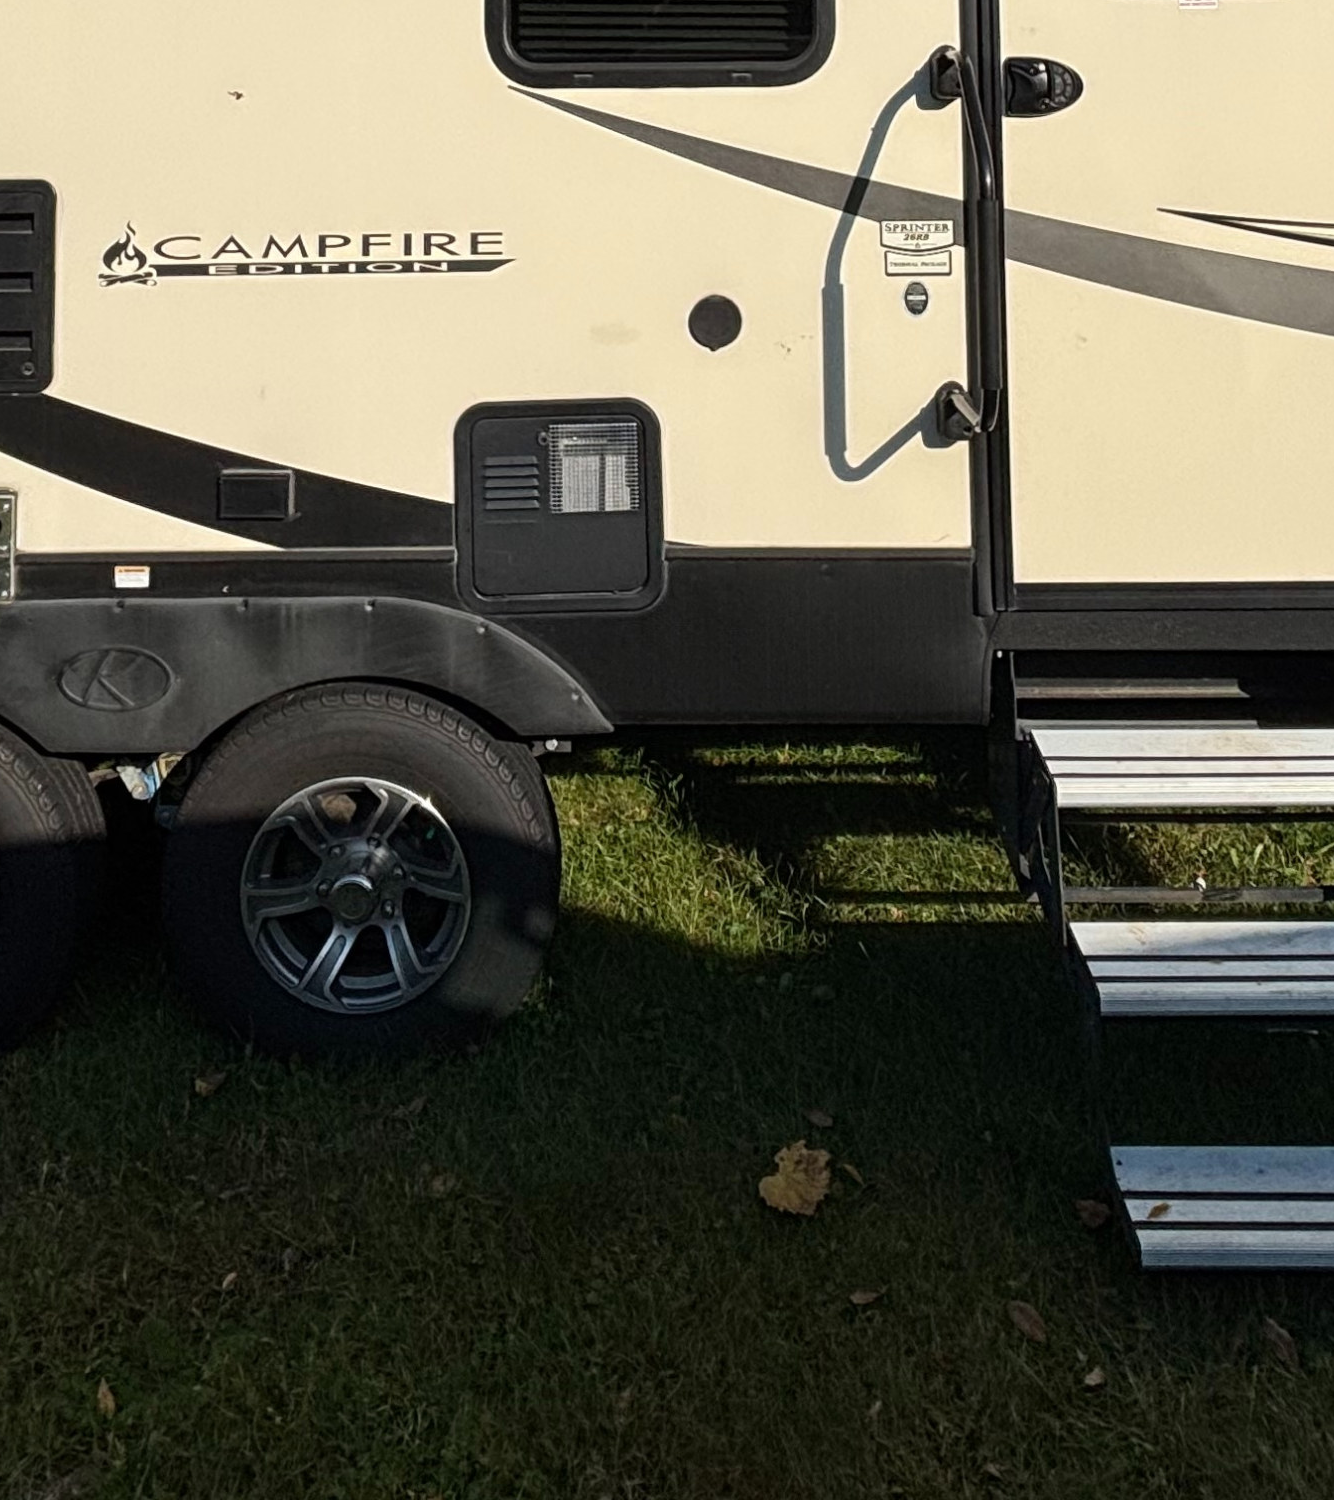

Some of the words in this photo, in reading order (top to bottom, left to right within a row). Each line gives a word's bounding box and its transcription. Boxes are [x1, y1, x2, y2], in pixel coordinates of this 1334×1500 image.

[884, 223, 950, 232] SPRINTER
[153, 231, 504, 260] CAMPFIRE
[208, 262, 449, 276] EDITION
